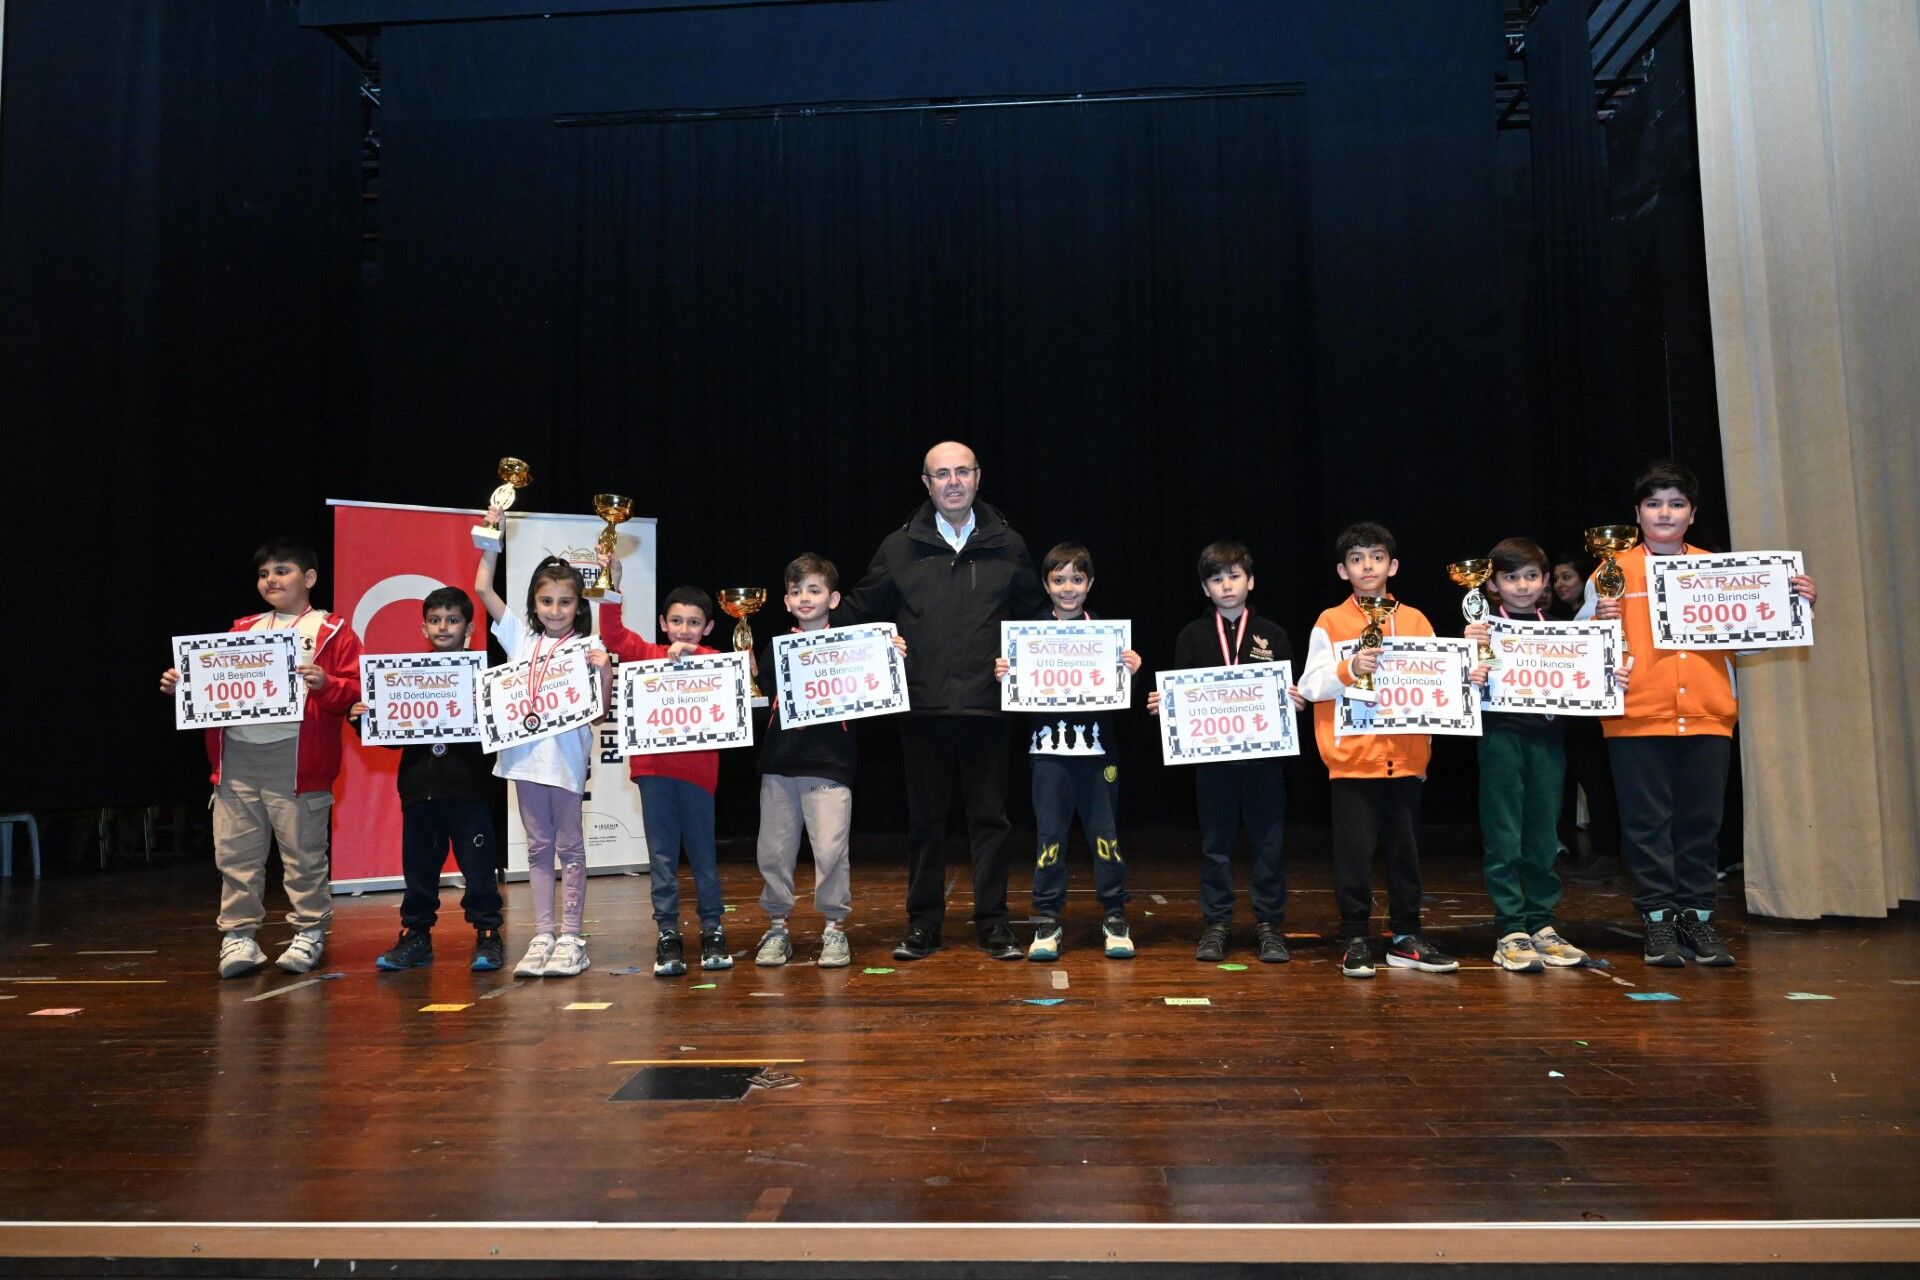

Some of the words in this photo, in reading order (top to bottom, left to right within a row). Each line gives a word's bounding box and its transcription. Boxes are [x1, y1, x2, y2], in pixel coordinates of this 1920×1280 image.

[1680, 573, 1771, 590] SATRANÇ
[1692, 594, 1714, 603] U10
[1717, 591, 1760, 602] Birincisi
[1682, 603, 1747, 624] 5000
[1503, 643, 1588, 657] SATRANÇ
[202, 652, 274, 668] SATRANÇ
[1036, 659, 1055, 667] U10
[1376, 659, 1447, 674] ATRANÇ
[1516, 659, 1537, 667] U10
[1540, 658, 1575, 669] İkincisi
[213, 671, 225, 681] U8
[228, 670, 266, 681] Beşincisi
[386, 674, 460, 687] SATRANÇ
[815, 669, 828, 678] U8
[1030, 669, 1083, 687] 1000
[1392, 675, 1442, 686] Üçüncüsü
[1501, 669, 1564, 688] 4000
[204, 680, 256, 701] 1000
[646, 676, 722, 693] SATRANÇ
[805, 676, 858, 699] 5000
[389, 692, 402, 700] U8
[403, 691, 457, 699] Dördüncüsü
[511, 691, 523, 700] U8
[662, 697, 675, 706] U8
[678, 695, 709, 705] İkincisi
[1364, 687, 1424, 708] 000
[387, 701, 439, 720] 2000
[506, 692, 559, 721] 3000
[1189, 707, 1207, 716] U10
[1211, 704, 1265, 715] Dördüncüsü
[646, 705, 702, 726] 4000
[1190, 715, 1245, 737] 2000
